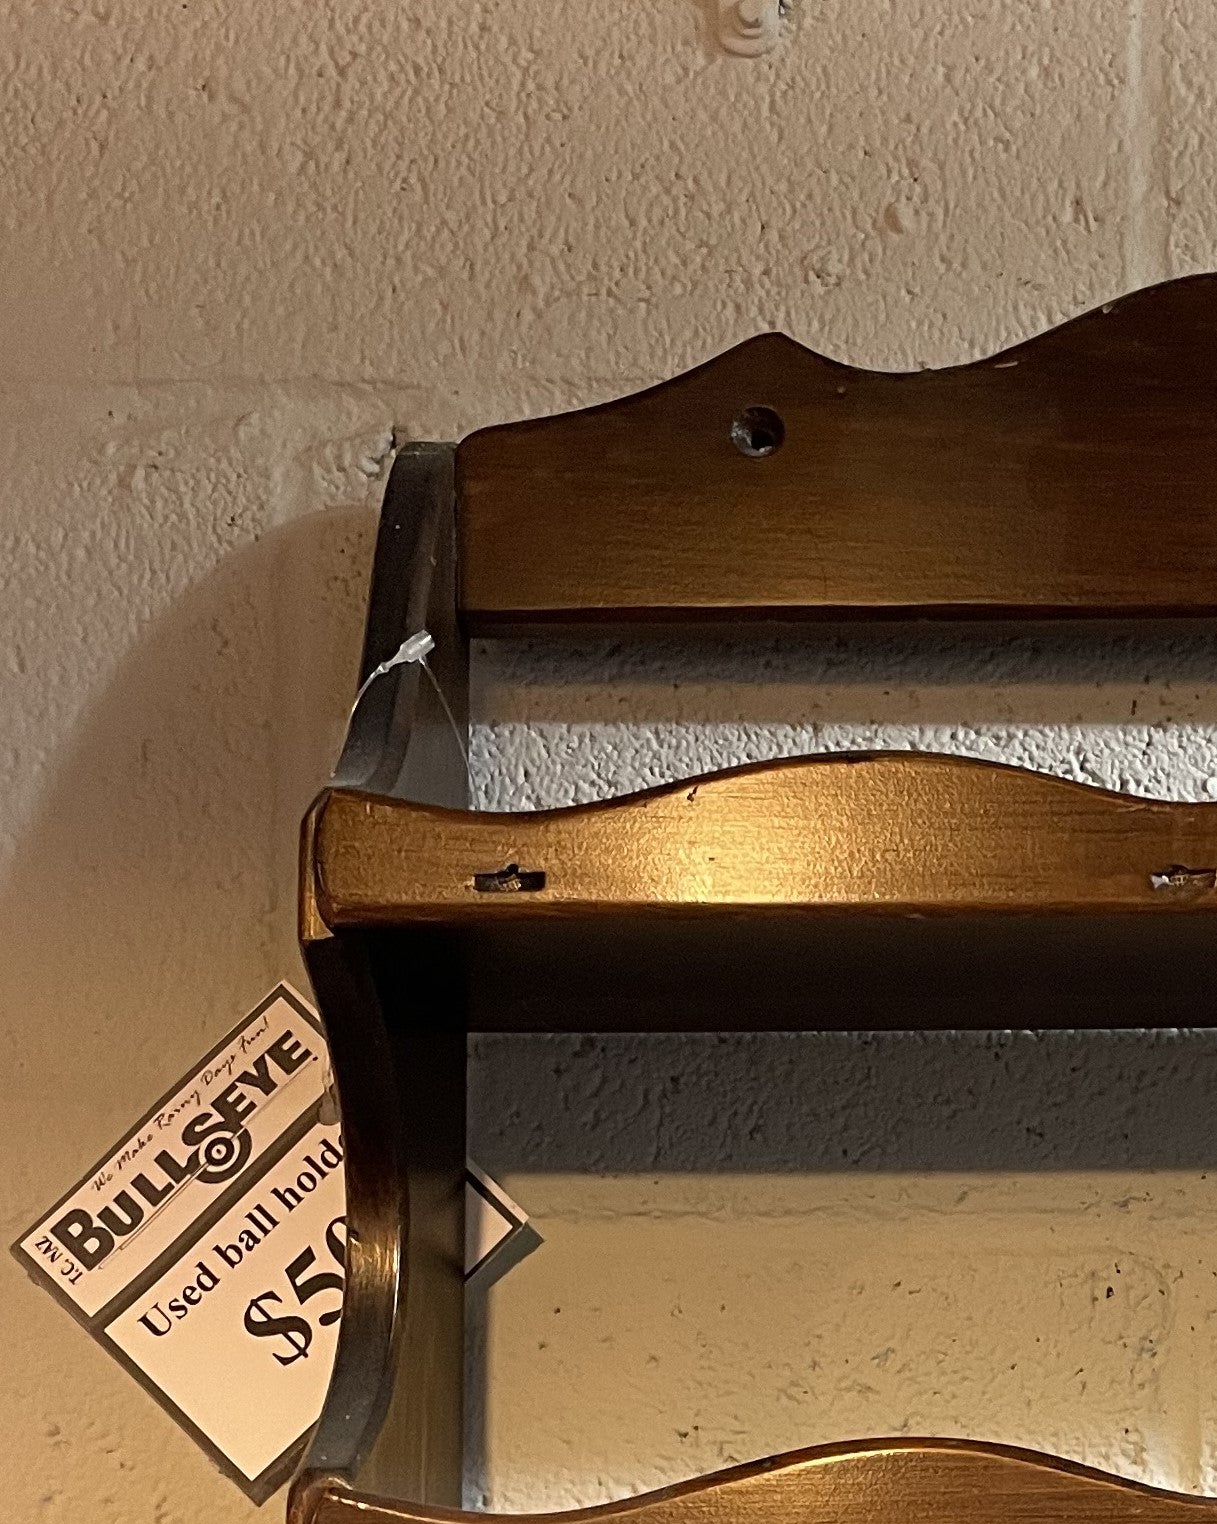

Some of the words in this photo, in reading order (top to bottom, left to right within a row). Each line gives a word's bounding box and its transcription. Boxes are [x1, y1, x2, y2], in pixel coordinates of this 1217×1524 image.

[50, 1030, 313, 1271] BULLSEYE
[92, 1171, 113, 1191] We
[115, 1133, 153, 1170] Make
[200, 1054, 236, 1085] Days
[239, 1015, 270, 1054] Fun!
[137, 1261, 221, 1336] Used
[212, 1203, 281, 1269] ball
